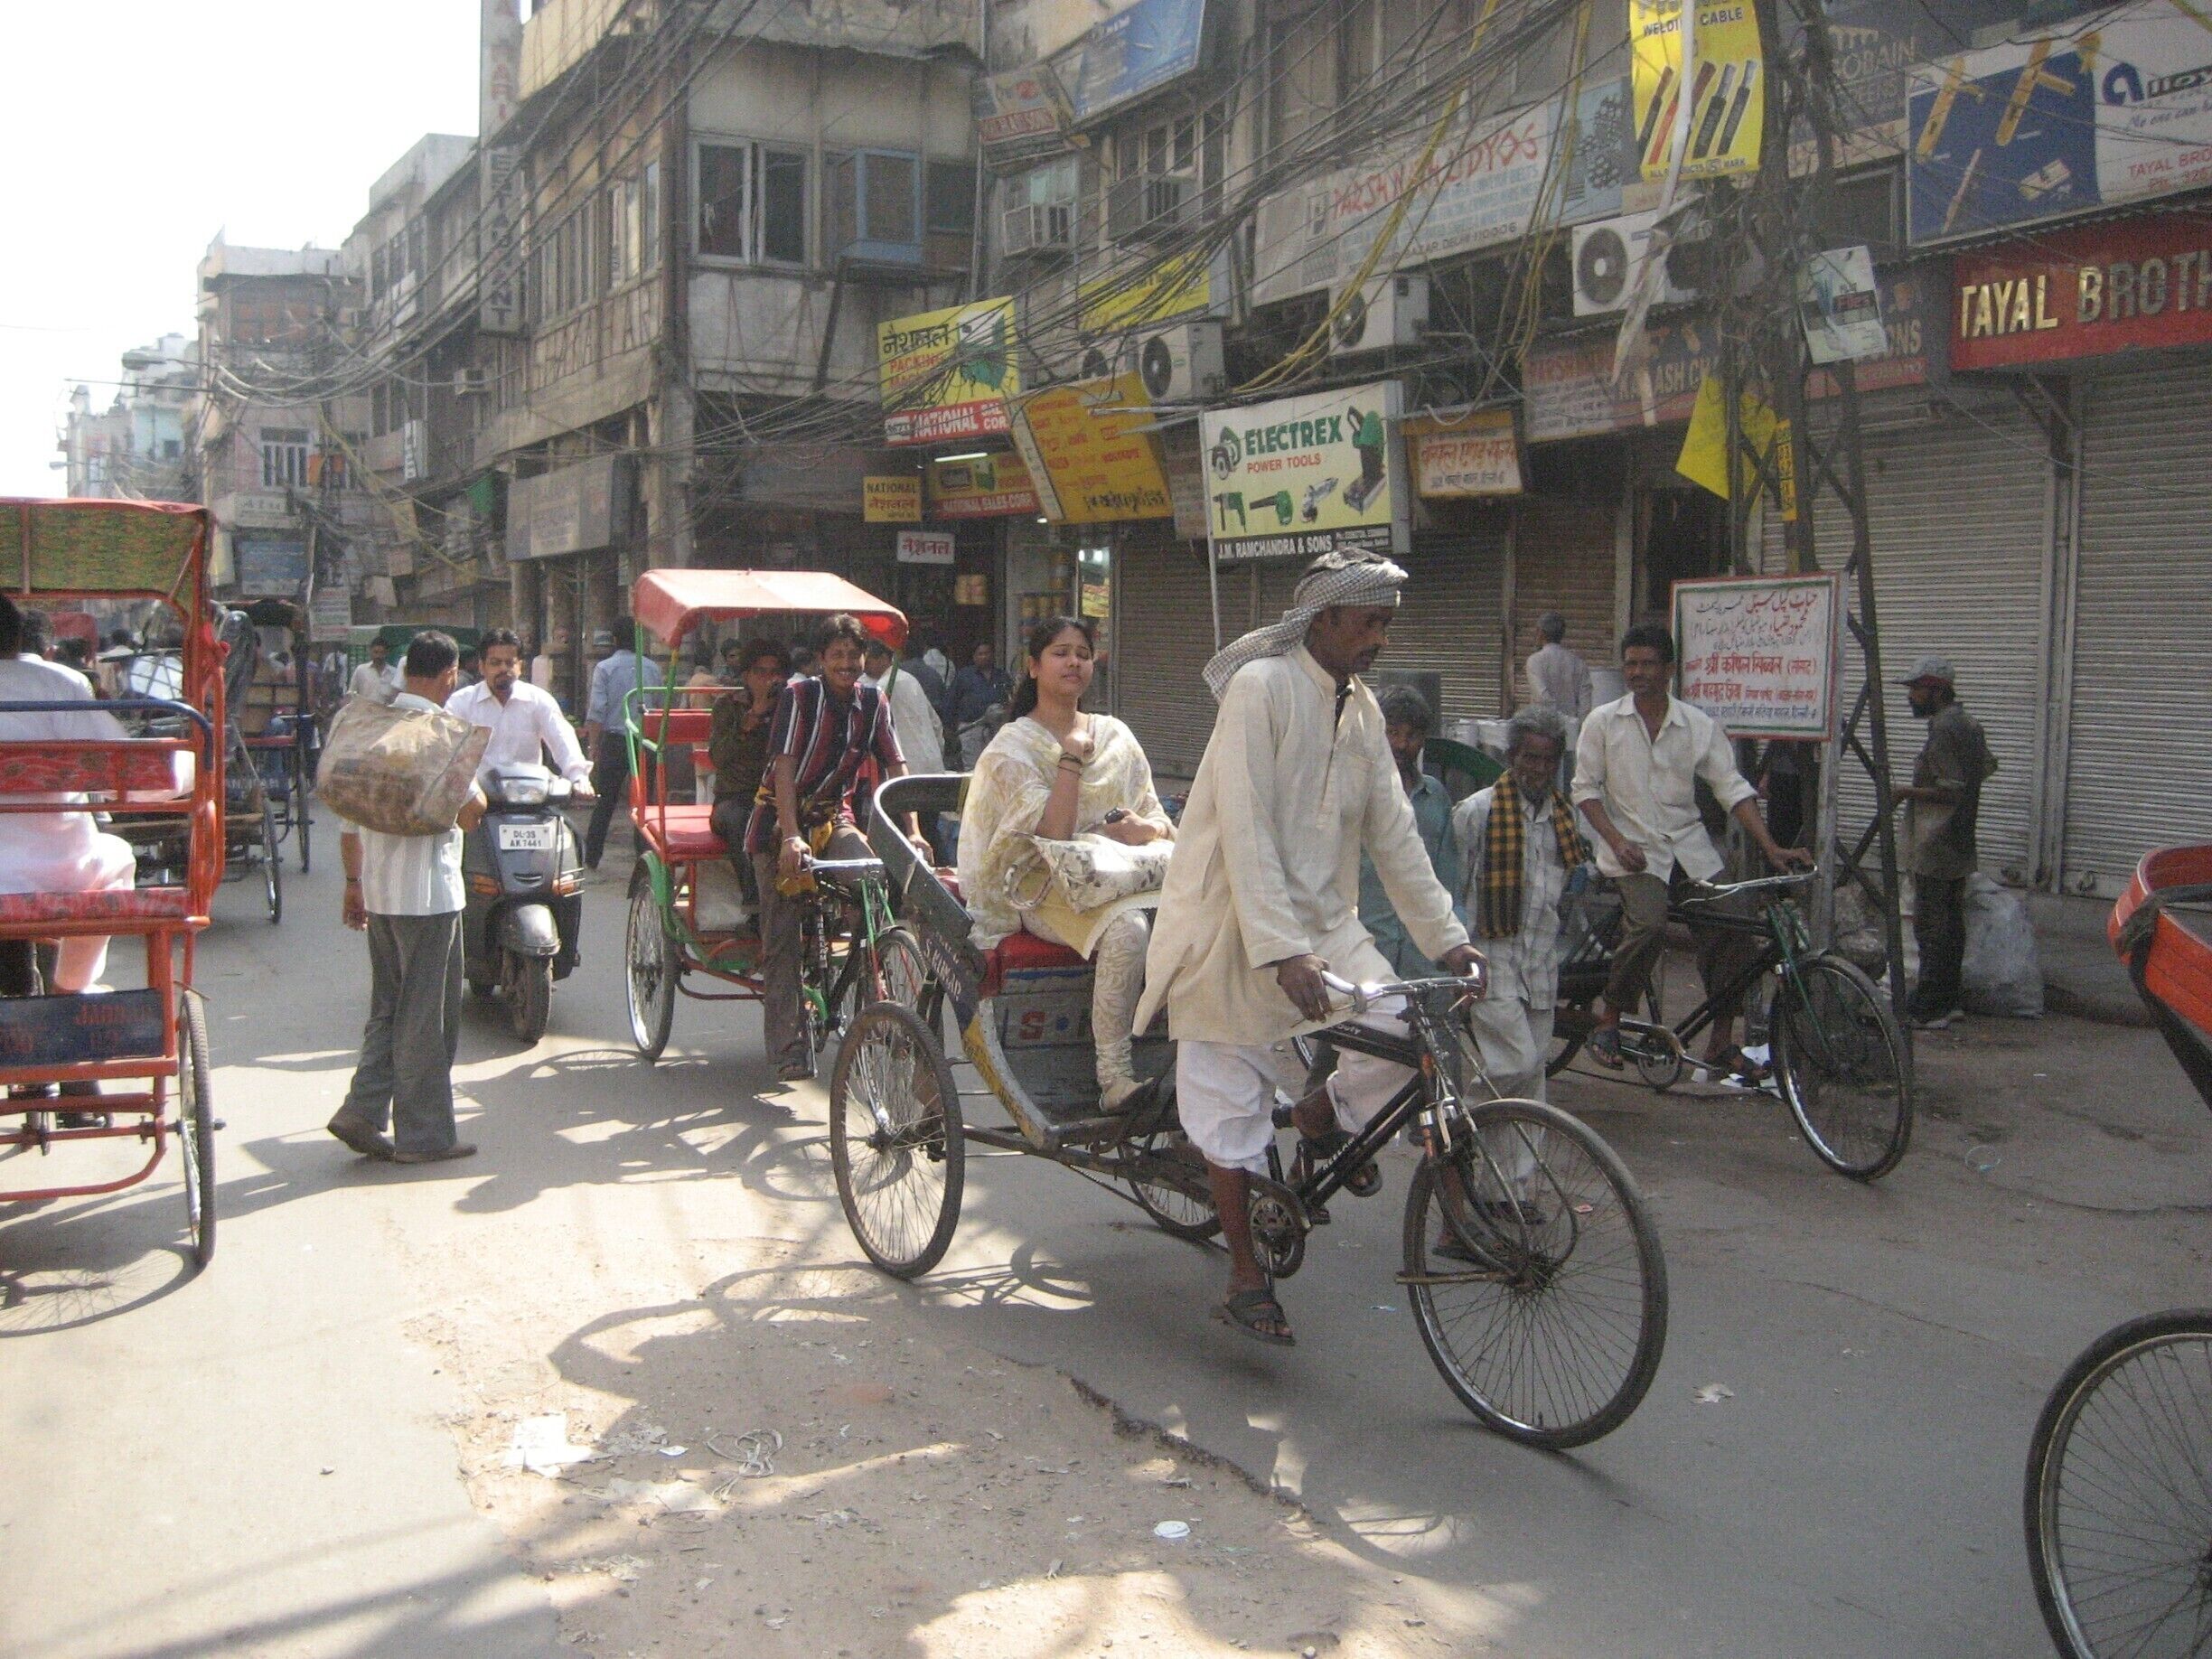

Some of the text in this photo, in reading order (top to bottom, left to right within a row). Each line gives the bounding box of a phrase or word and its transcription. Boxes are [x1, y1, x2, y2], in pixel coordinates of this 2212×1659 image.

[1700, 7, 1743, 25] CABLE
[2128, 157, 2174, 179] TAYAL
[1962, 275, 2059, 340] TAYAL
[914, 407, 979, 439] NATIONAL
[1244, 414, 1344, 456] ELECTREX
[1246, 452, 1322, 474] POWER TOOLS
[867, 483, 917, 493] NATIONAL
[1236, 539, 1296, 558] RAMCHANDRA
[1298, 538, 1305, 554] &
[1306, 535, 1333, 553] SONS
